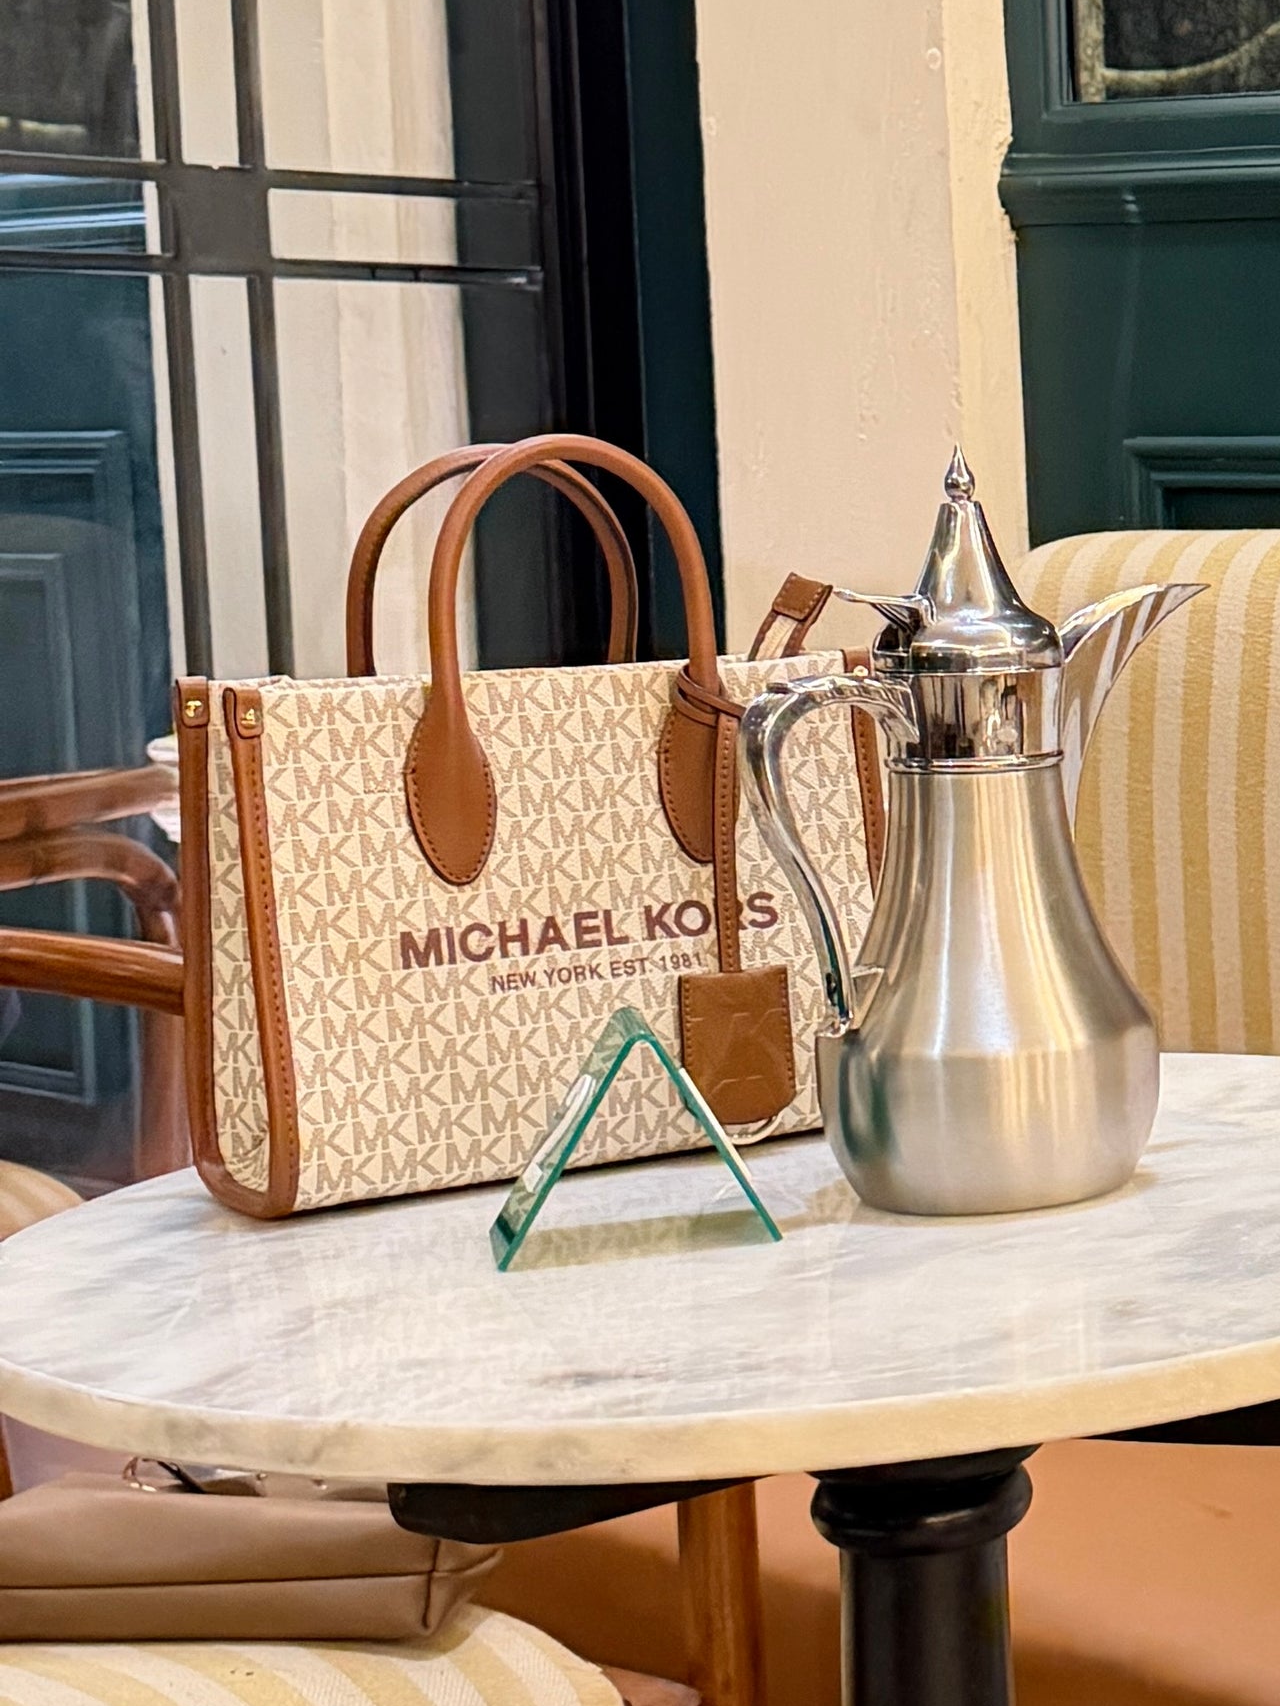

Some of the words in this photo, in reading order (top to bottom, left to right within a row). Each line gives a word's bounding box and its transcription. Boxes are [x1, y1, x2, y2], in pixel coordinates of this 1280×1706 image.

[399, 909, 630, 970] MICHAEL
[643, 891, 780, 941] KOS
[491, 972, 537, 994] NEW
[542, 962, 602, 988] YORK
[660, 951, 702, 973] 1981
